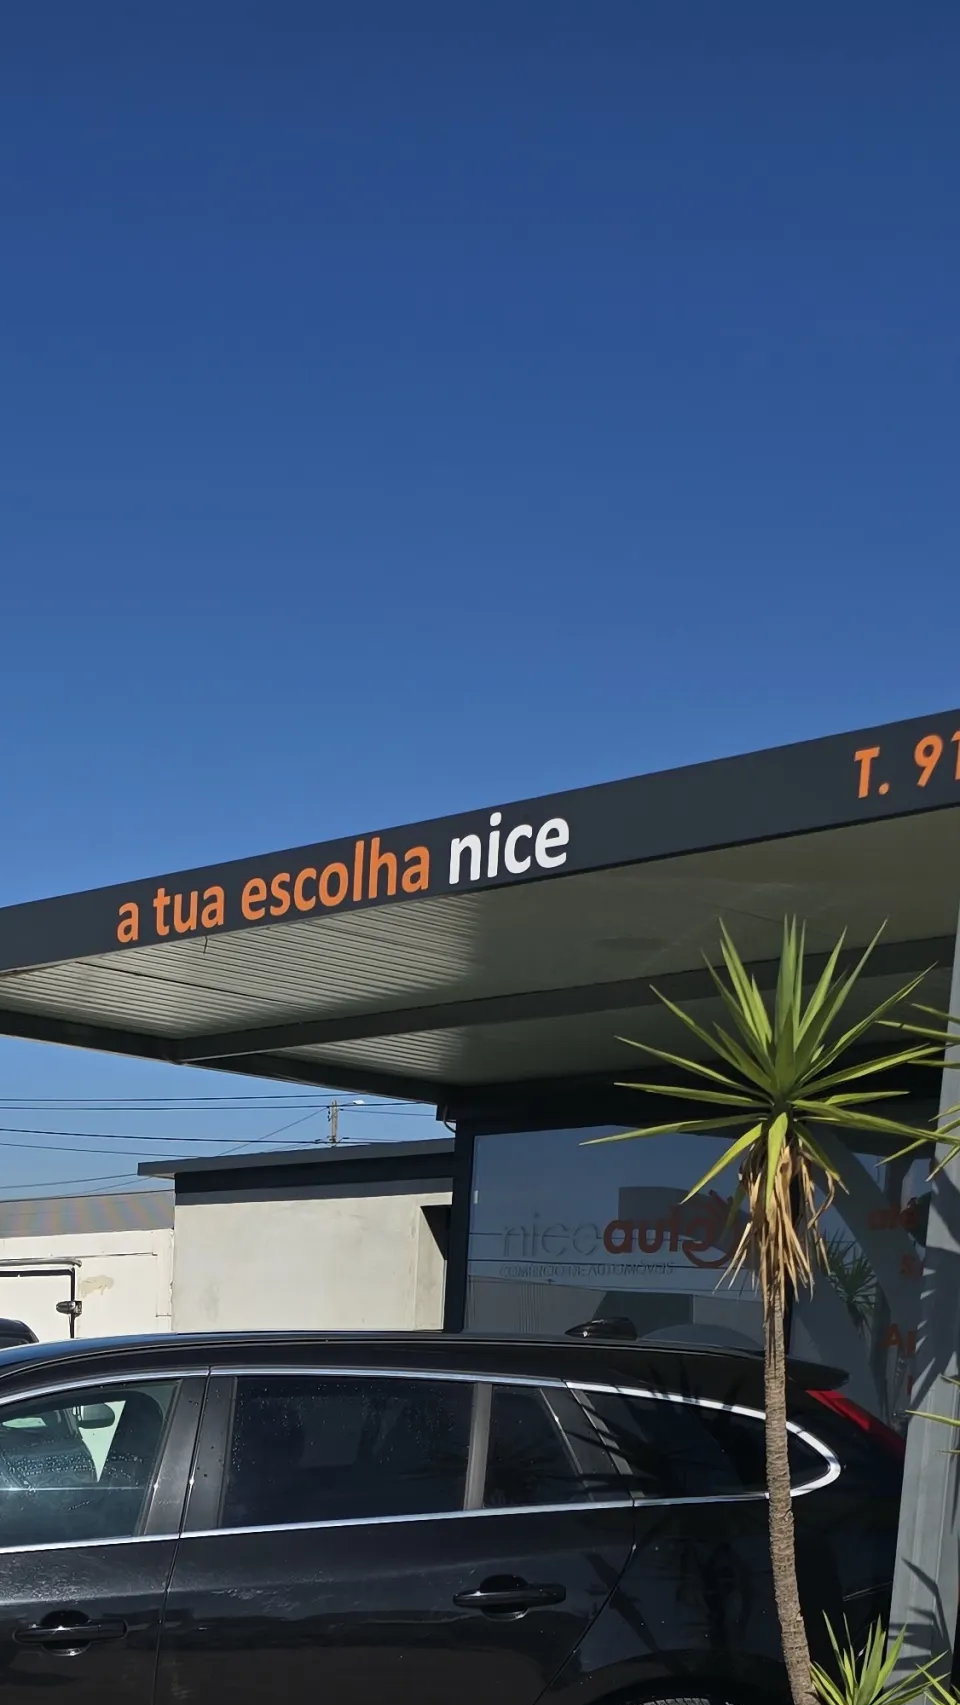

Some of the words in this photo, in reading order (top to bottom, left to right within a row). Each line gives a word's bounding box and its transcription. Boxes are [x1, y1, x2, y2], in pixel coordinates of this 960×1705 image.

[853, 745, 889, 798] T.
[116, 902, 139, 943] a
[153, 887, 225, 936] tua
[241, 837, 431, 921] escolha
[449, 811, 570, 884] nice
[502, 1211, 599, 1258] nice
